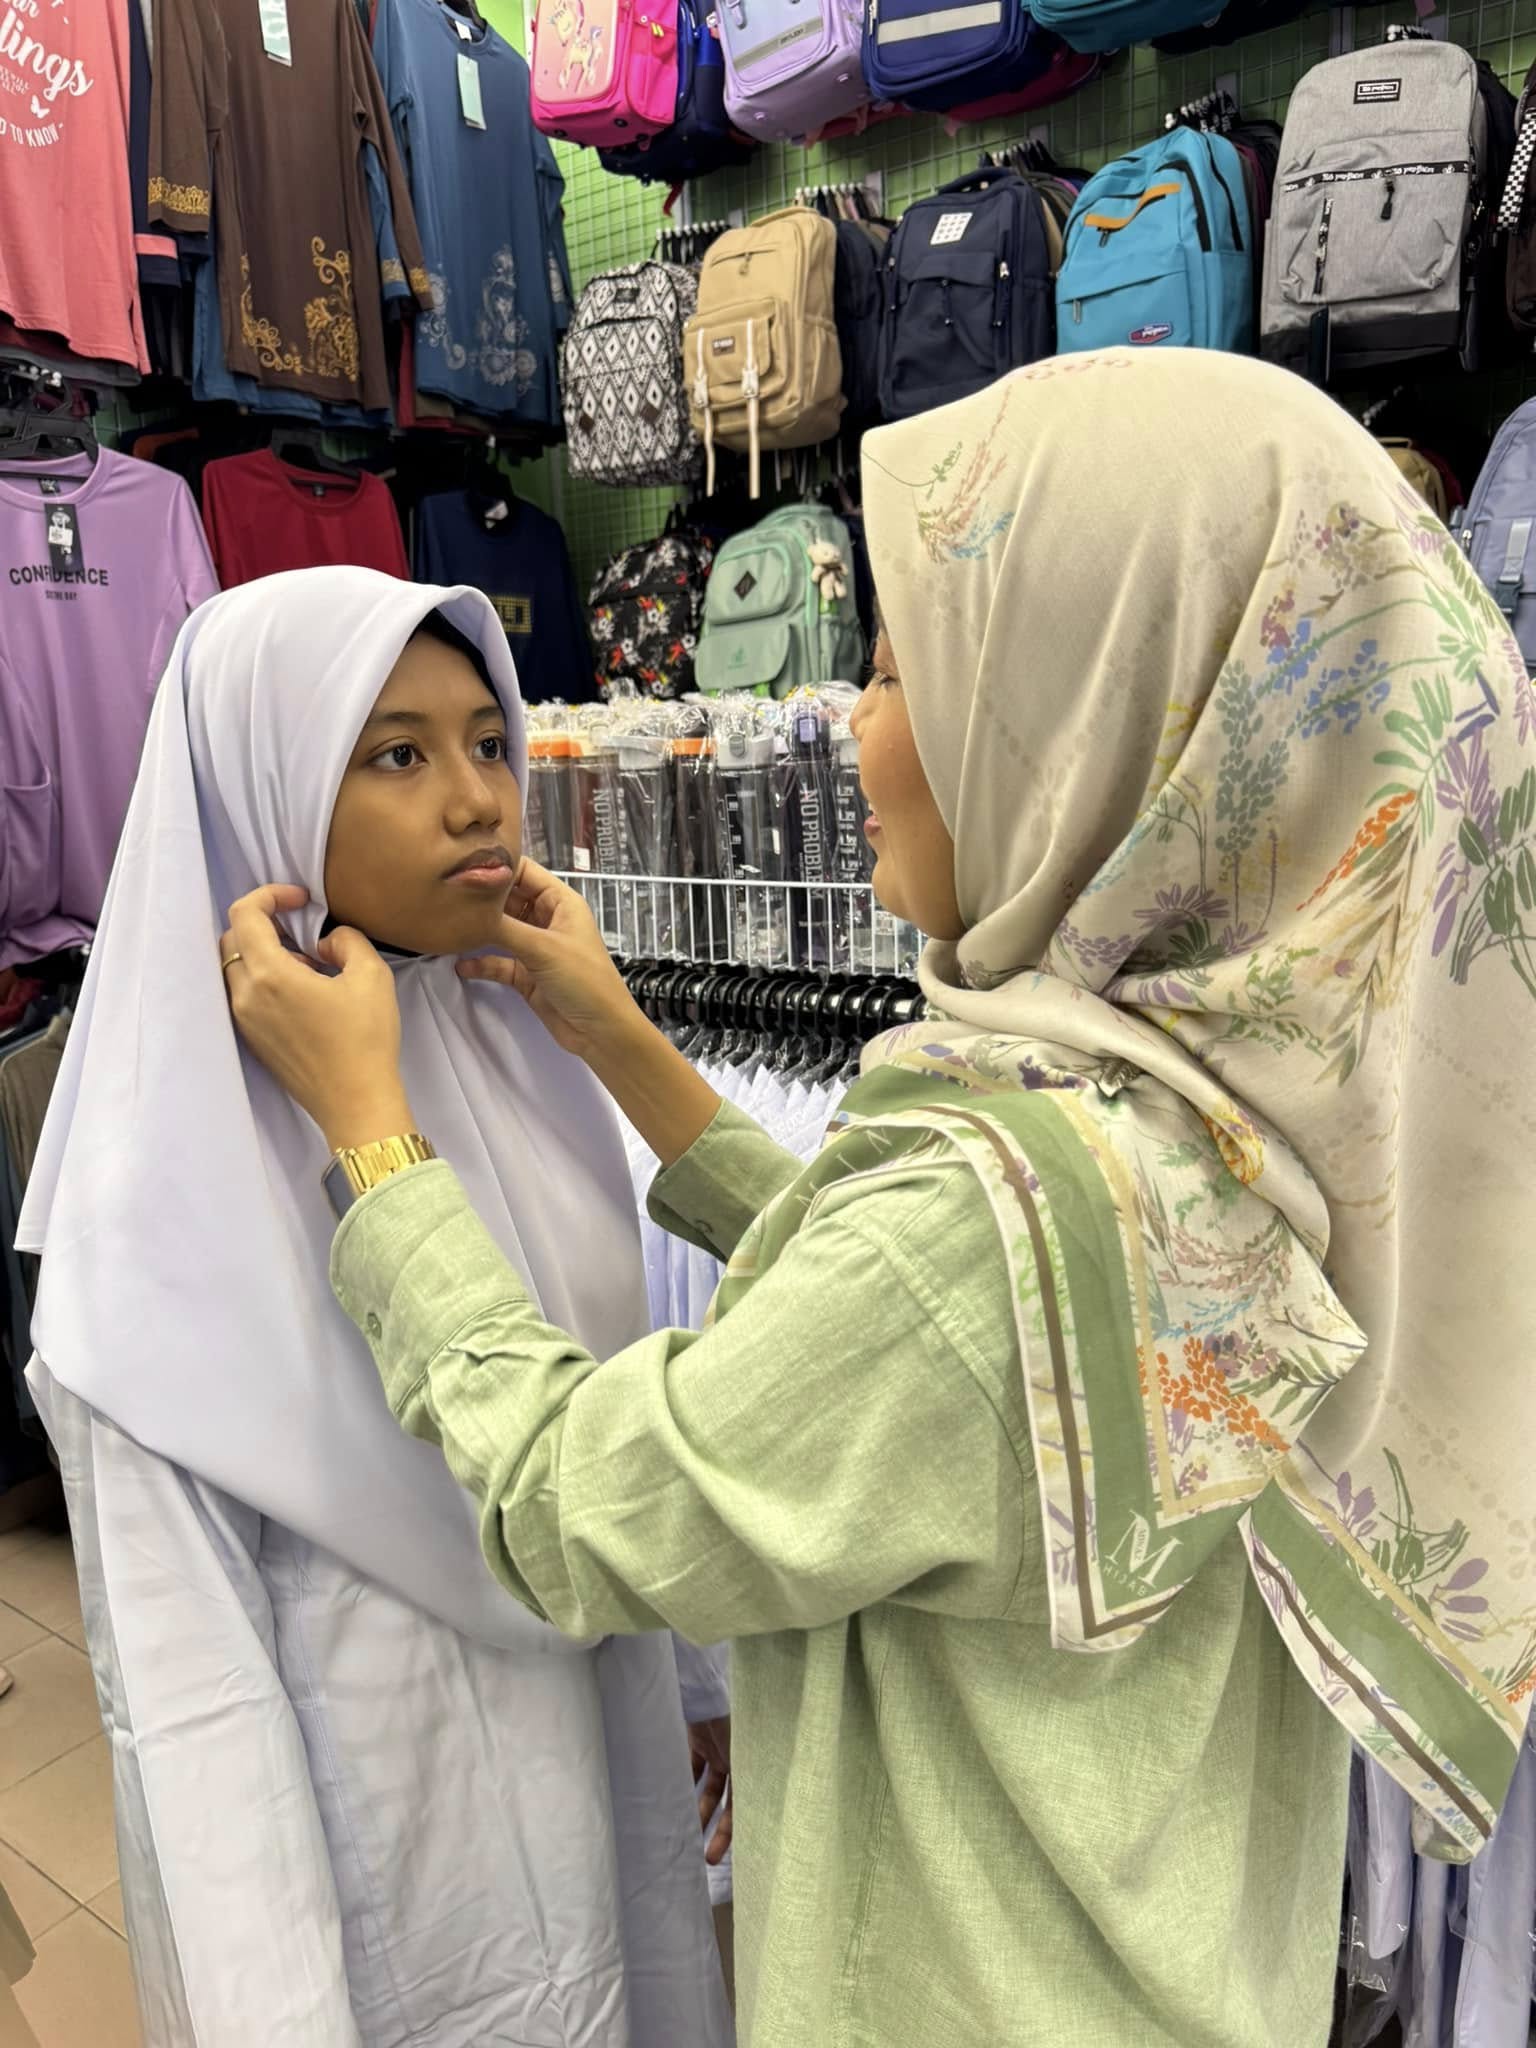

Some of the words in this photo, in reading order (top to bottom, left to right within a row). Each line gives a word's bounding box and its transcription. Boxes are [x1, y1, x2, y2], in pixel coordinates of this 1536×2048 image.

[9, 122, 24, 145] TO
[25, 122, 60, 148] KNOW
[9, 564, 110, 586] CONFIDENCE
[593, 788, 612, 814] NO
[800, 788, 820, 817] NO
[1103, 1563, 1147, 1597] HIJAB
